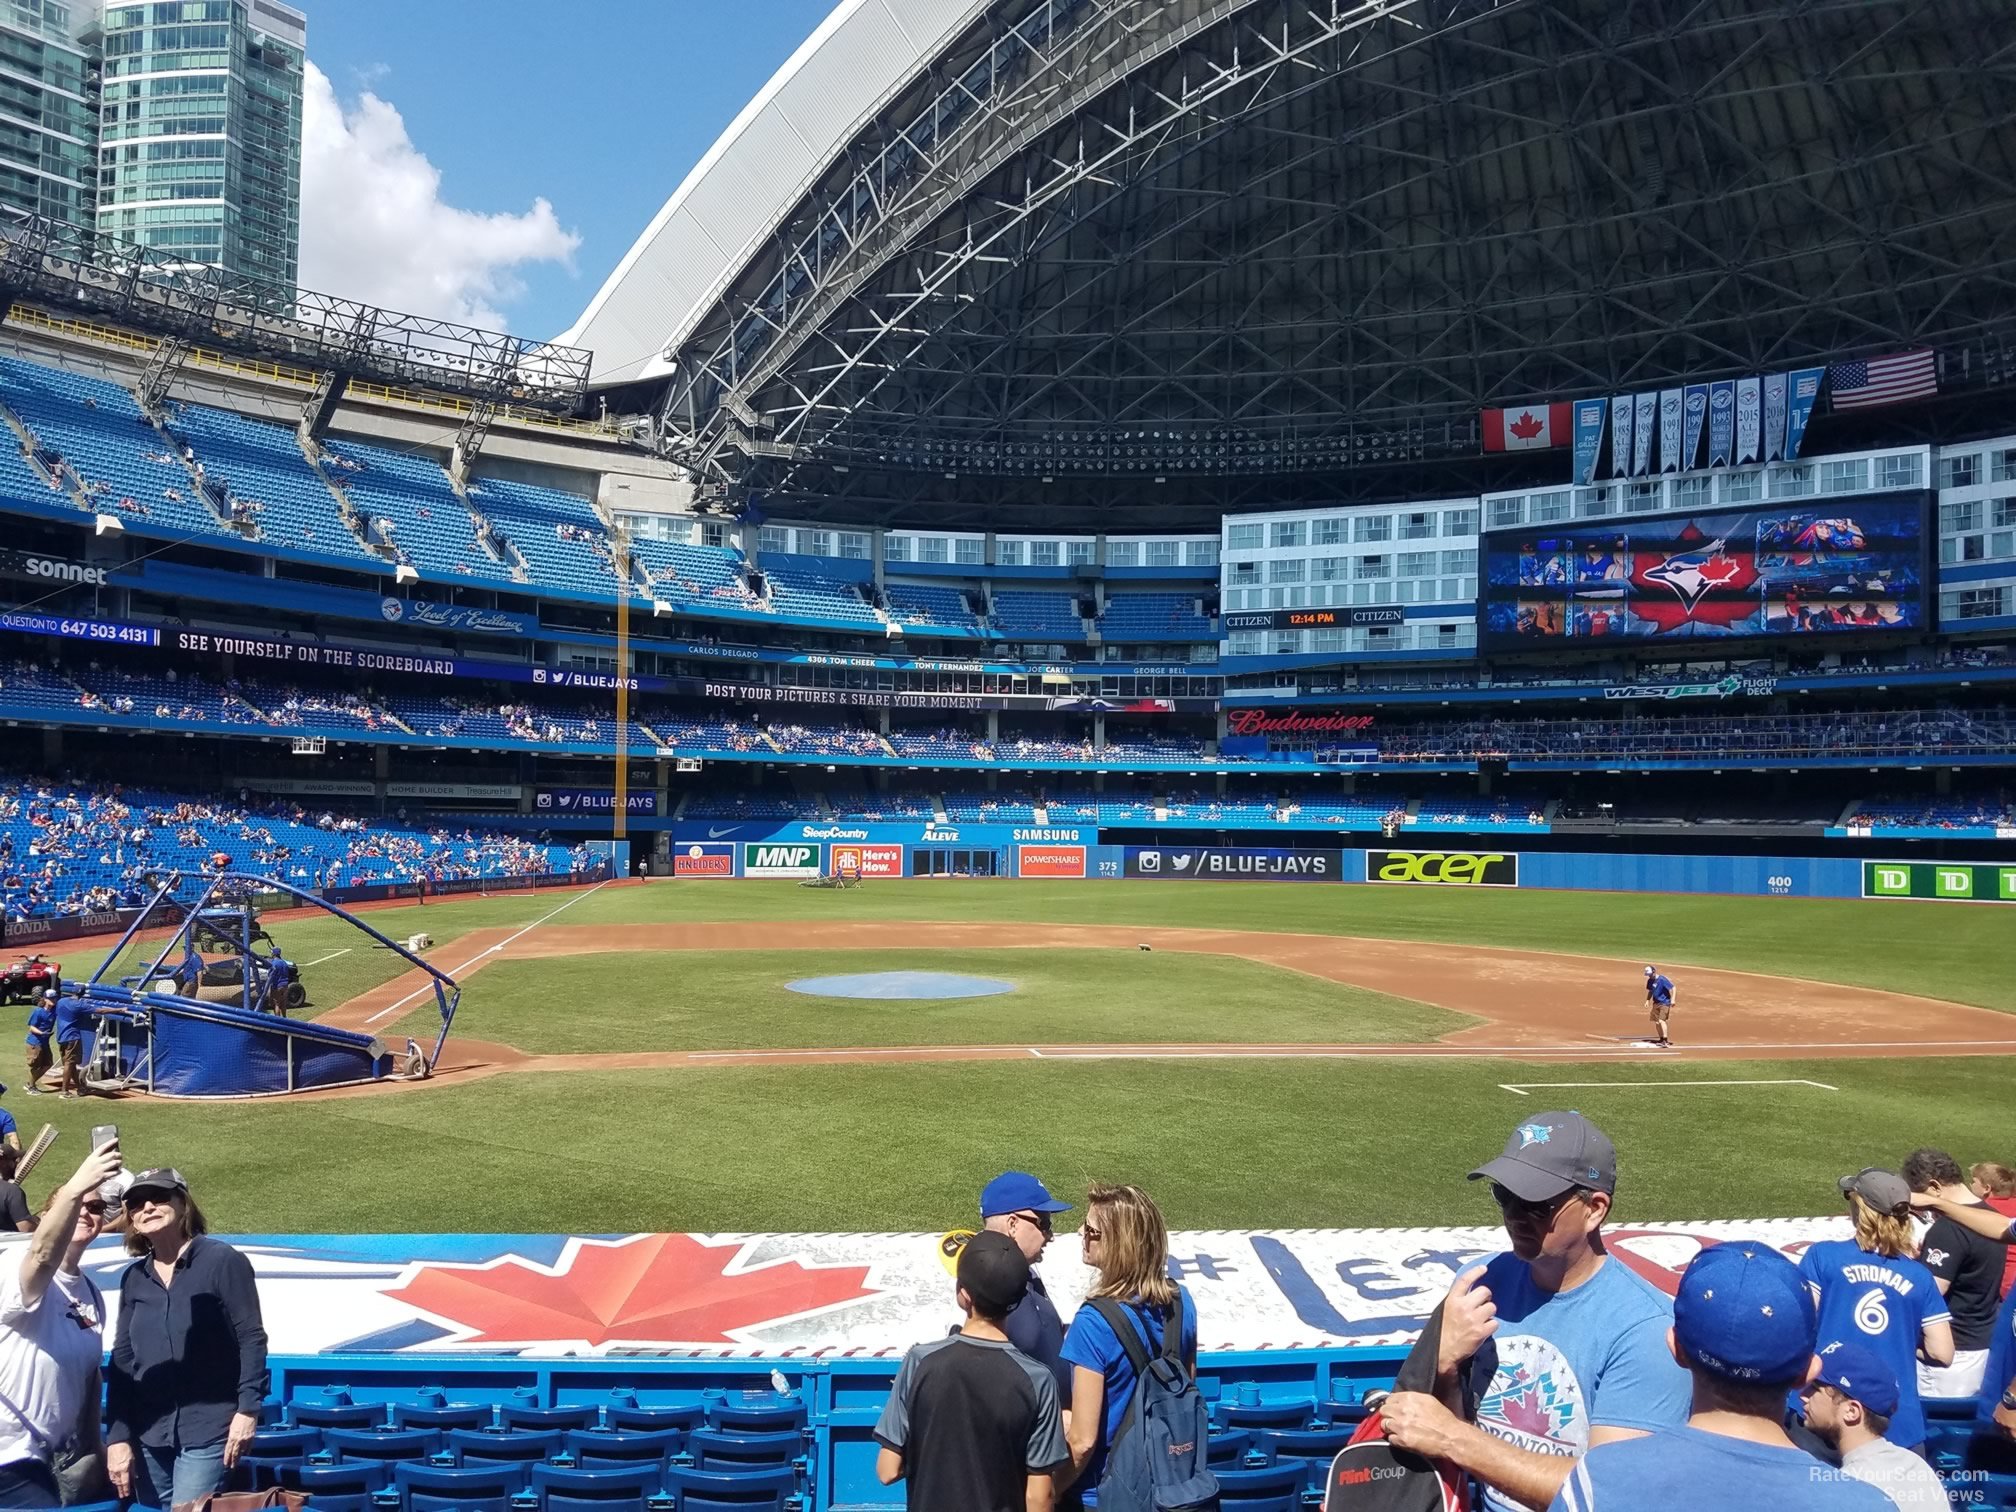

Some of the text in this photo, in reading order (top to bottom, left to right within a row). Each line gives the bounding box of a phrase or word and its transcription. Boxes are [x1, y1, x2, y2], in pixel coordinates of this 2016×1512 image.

[1712, 411, 1731, 425] 1993
[1739, 409, 1759, 422] 2015
[1766, 406, 1784, 419] 2016
[1663, 419, 1680, 431] 1991
[1687, 415, 1701, 427] 199
[1637, 423, 1651, 434] 198
[25, 557, 107, 586] sonnet
[409, 601, 523, 633] Level of Excellence
[1226, 615, 1272, 627] CITIZEN
[1289, 613, 1335, 624] 12:14 PM
[1353, 610, 1402, 622] CITIZEN
[2, 614, 148, 643] QUESTION TO 647 503 4131
[179, 633, 454, 675] SEE YOURSELF ON THE SCOREBOARD
[688, 646, 759, 659] CARLOS DELGADO
[807, 656, 876, 667] 4306 TOM CHEEK
[914, 662, 984, 672] TONY FERNANDEZ
[1027, 666, 1074, 674] JOE CARTER
[1133, 667, 1187, 675] GEORGE BELL
[1743, 679, 1778, 688] FLIGHT
[705, 684, 983, 709] POST YOUR PICTURES & SHARE YOUR MOMENT
[1606, 686, 1712, 698] WESTJET
[1747, 687, 1773, 696] DECK
[1229, 710, 1374, 734] Budweiser
[304, 784, 372, 793] AWARD-WINNING
[391, 785, 454, 795] HOME BUILDER
[921, 830, 959, 842] ALEVE
[1013, 829, 1079, 841] SAMSUNG
[755, 848, 811, 867] MNP
[862, 850, 897, 861] Here's
[862, 861, 891, 872] How.
[1099, 862, 1118, 871] 375
[1379, 852, 1504, 884] acer
[1768, 876, 1792, 887] 400
[1878, 870, 1907, 889] TD
[1939, 872, 1969, 891] TD
[2003, 874, 2016, 893] T
[81, 913, 122, 927] HONDA
[5, 921, 51, 937] HONDA
[1842, 1264, 1914, 1297] STROMAN
[1854, 1288, 1889, 1335] 6
